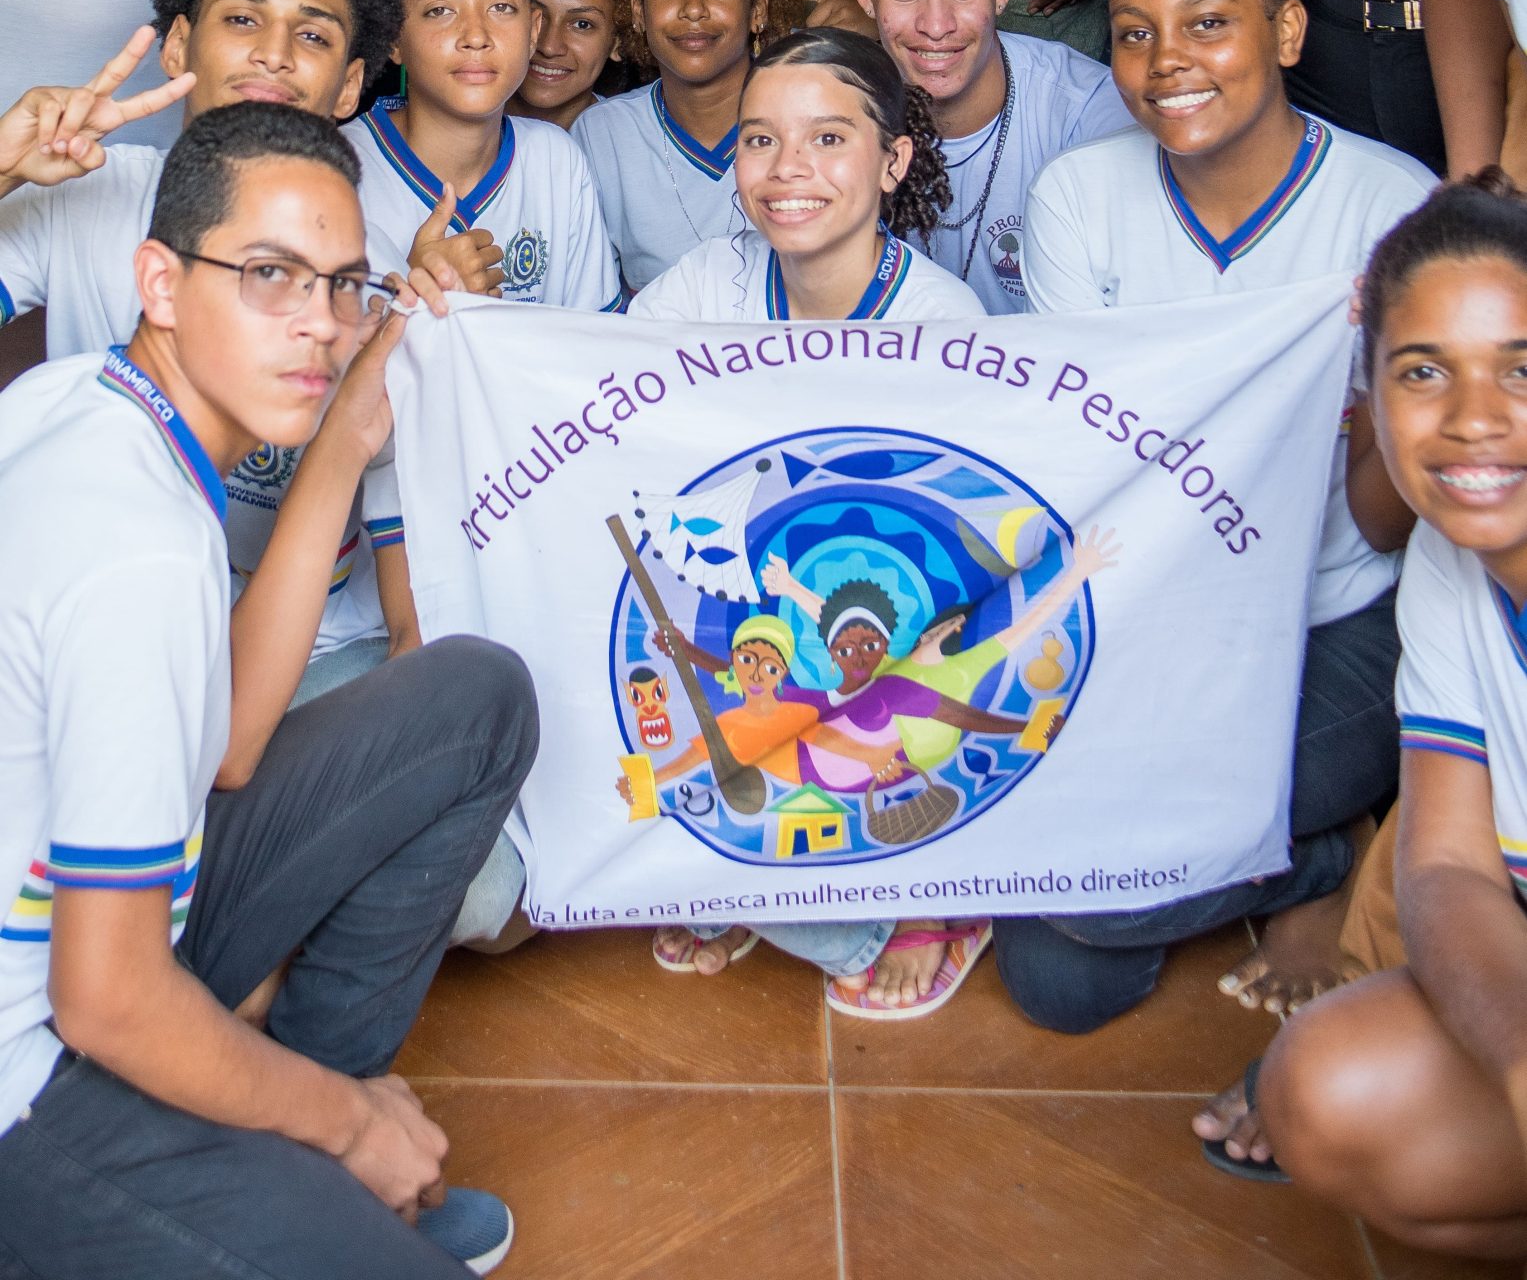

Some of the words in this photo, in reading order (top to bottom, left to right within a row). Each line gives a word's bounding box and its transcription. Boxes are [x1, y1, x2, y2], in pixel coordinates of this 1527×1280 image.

[986, 214, 1023, 238] PROJ
[675, 325, 924, 386] Nacional
[941, 331, 1037, 388] das
[1047, 362, 1262, 555] Pescdoras
[565, 903, 616, 922] luta
[625, 906, 641, 918] e
[649, 901, 681, 918] na
[689, 891, 767, 917] pesca
[775, 882, 901, 907] mulheres
[908, 868, 1073, 900] construindo
[1080, 863, 1189, 894] direitos!
